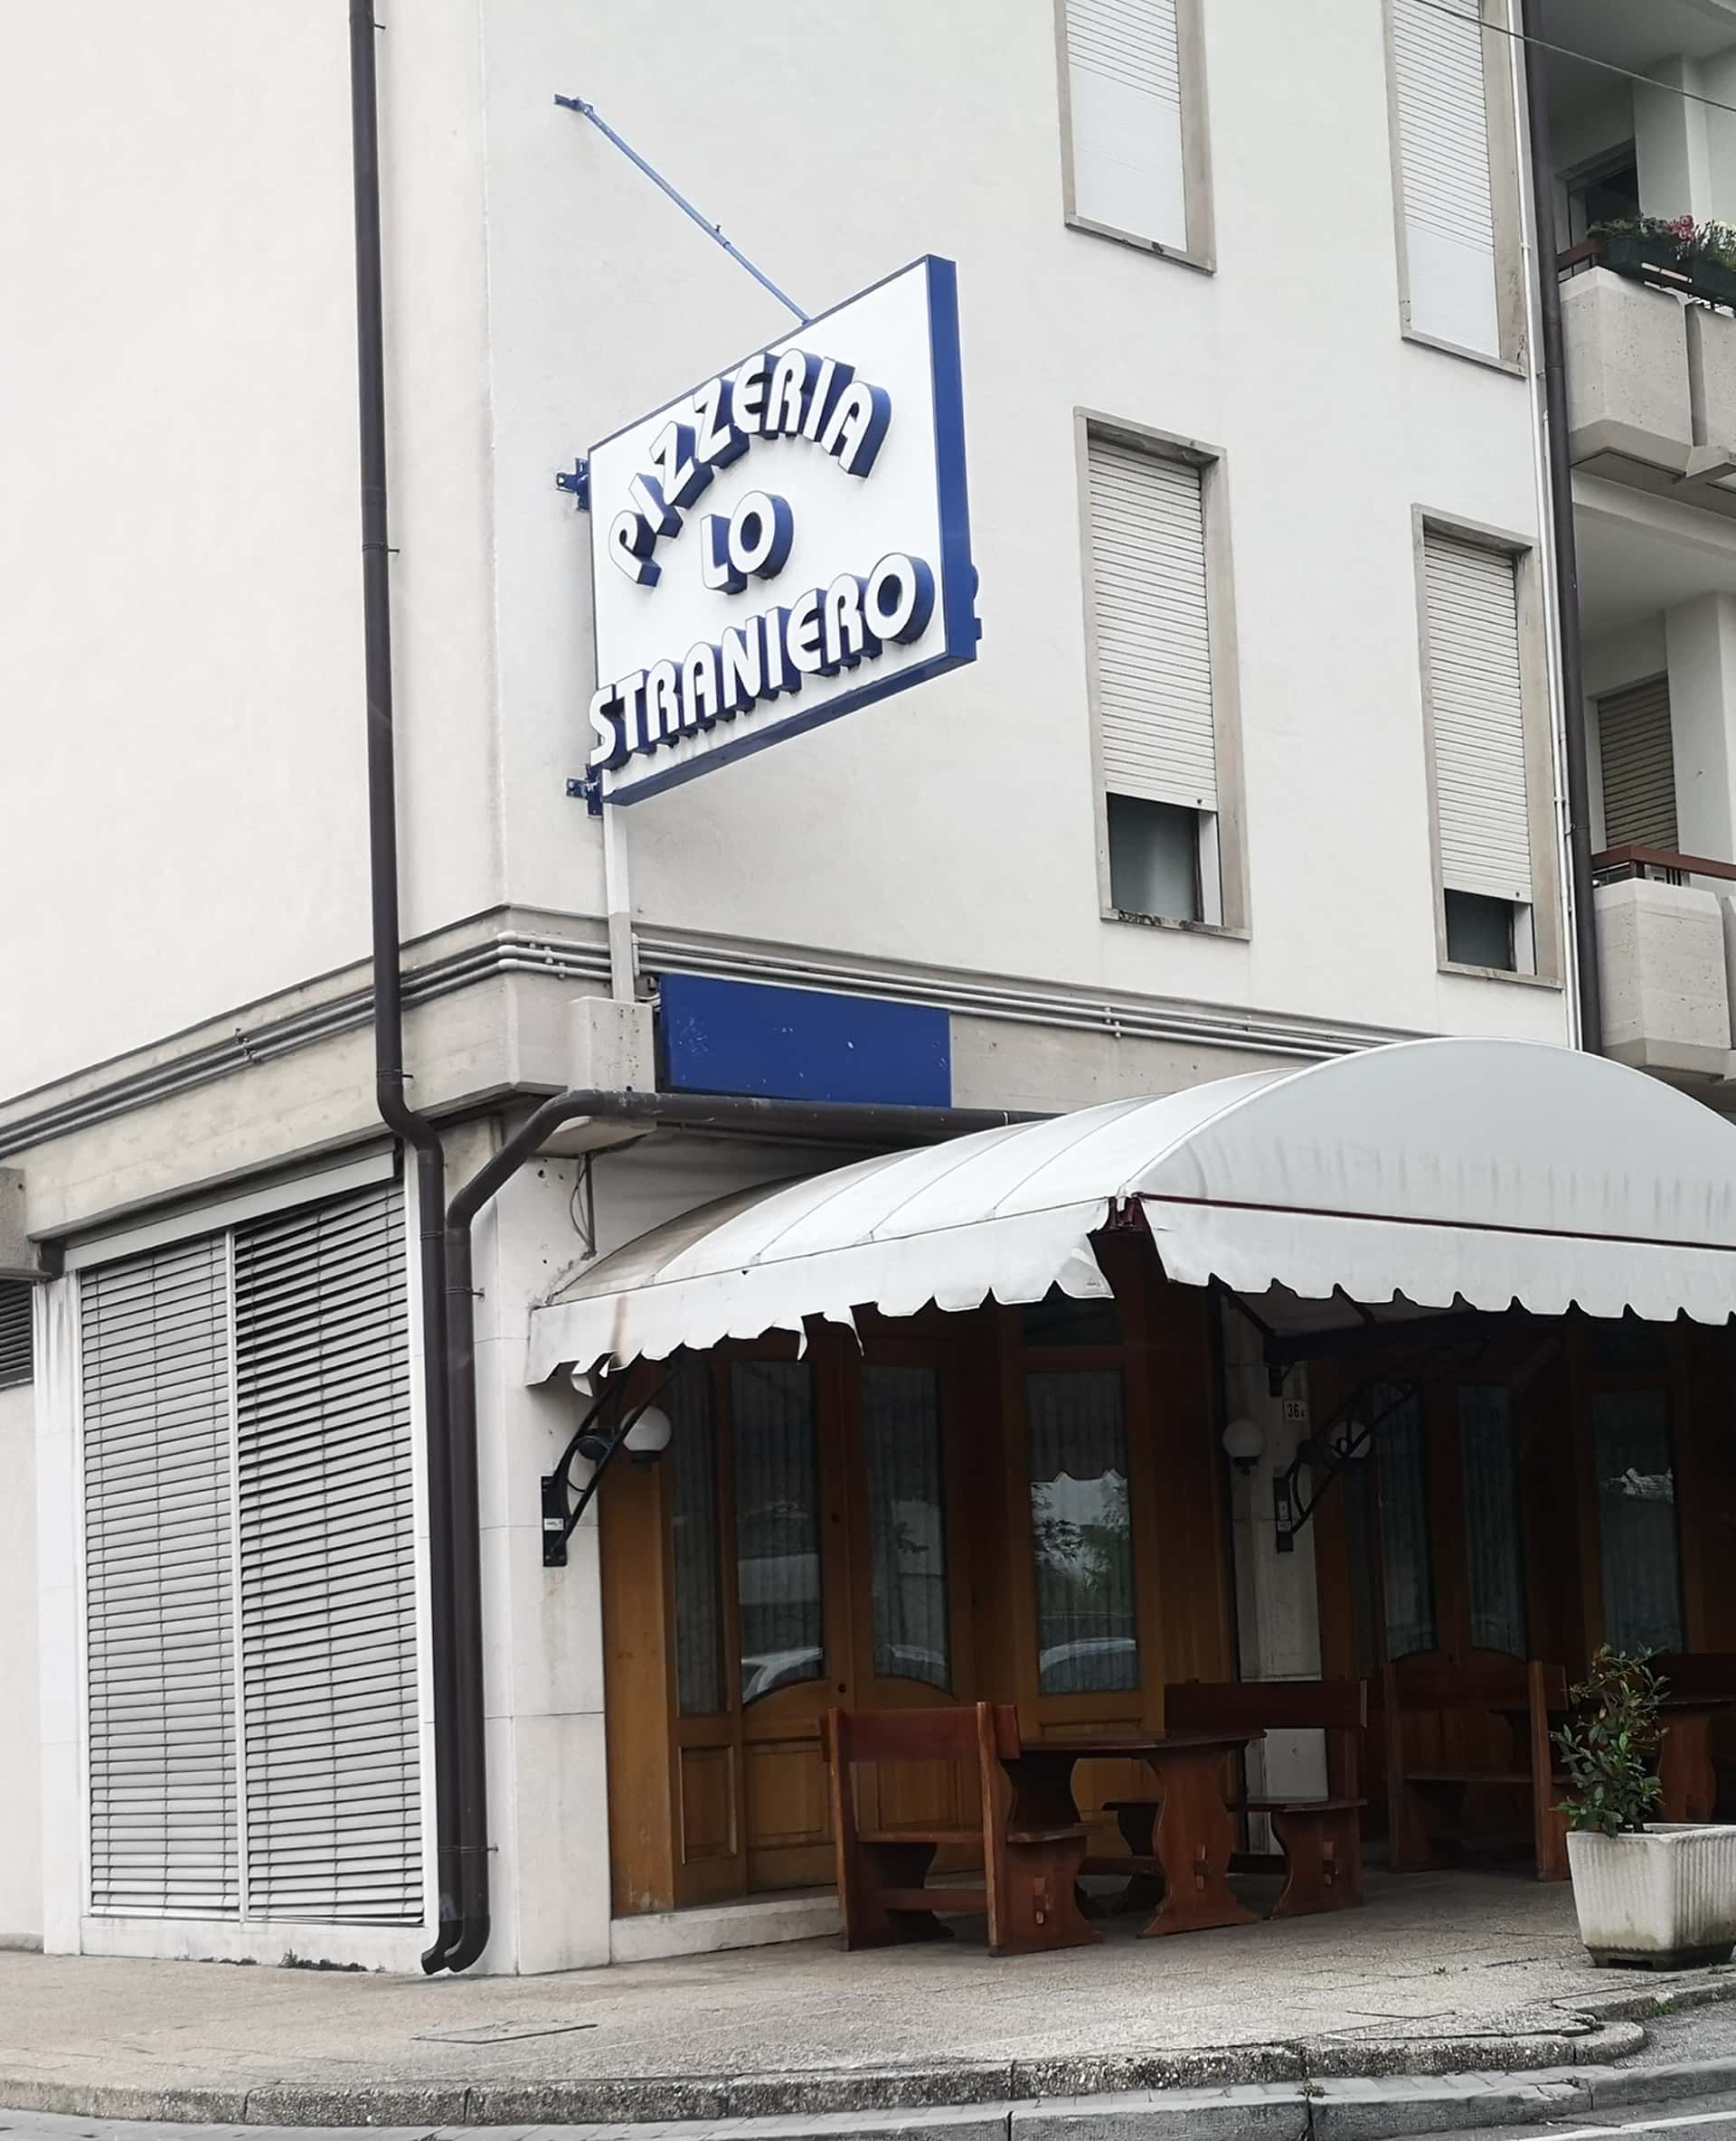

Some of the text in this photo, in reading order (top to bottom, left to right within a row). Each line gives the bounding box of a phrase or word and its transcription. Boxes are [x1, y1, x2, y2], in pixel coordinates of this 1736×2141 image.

[609, 348, 892, 588] PIZZERIA
[701, 490, 794, 595] LO
[590, 552, 936, 770] STRANIERO
